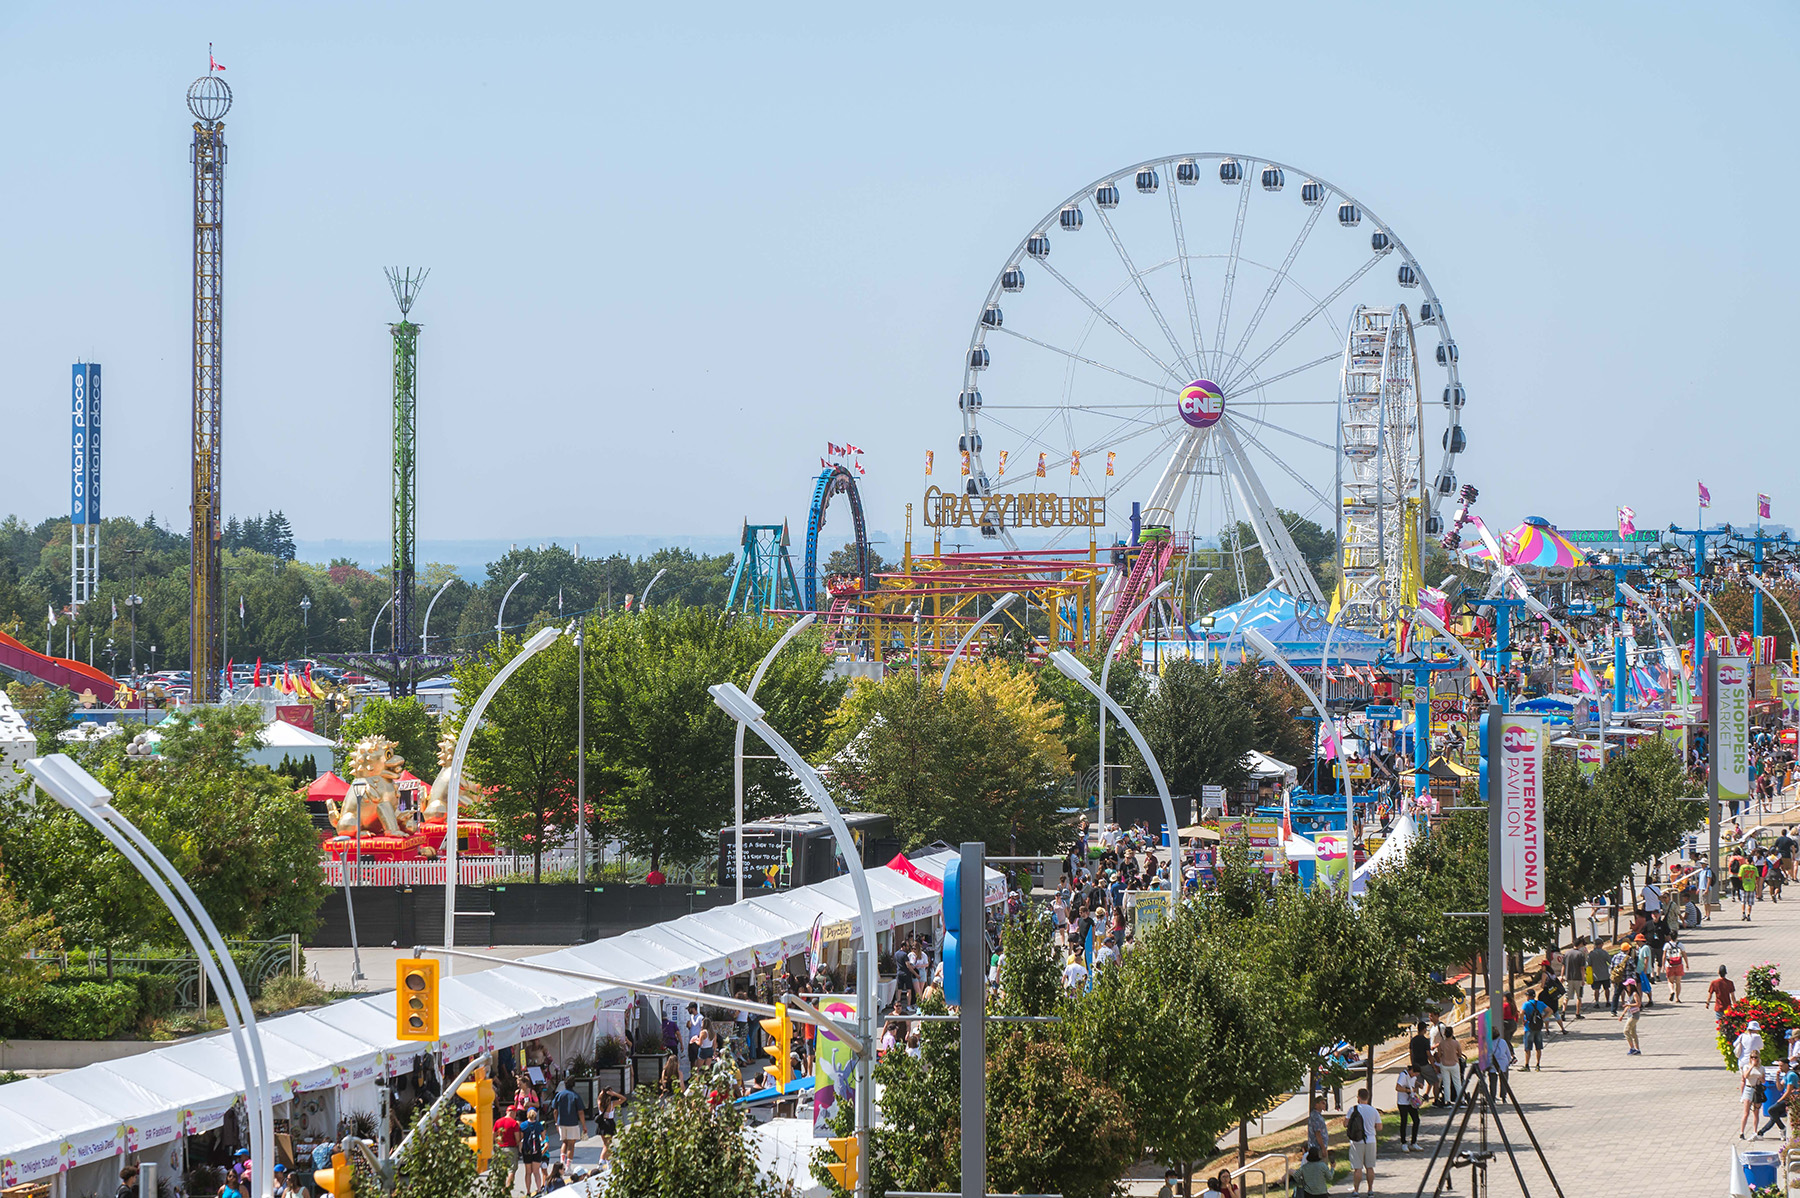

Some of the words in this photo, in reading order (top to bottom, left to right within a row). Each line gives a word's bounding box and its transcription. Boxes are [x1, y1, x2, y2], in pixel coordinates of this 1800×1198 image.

[72, 374, 85, 427] place
[90, 374, 101, 427] place
[1181, 397, 1222, 414] CNE
[73, 433, 84, 497] ontario
[91, 433, 100, 497] ontario
[924, 485, 1013, 528] CRAZY
[1016, 492, 1106, 528] MOUSE
[1624, 530, 1657, 542] ALLS
[1720, 669, 1744, 681] CNE
[1431, 711, 1467, 723] DOGS
[1719, 688, 1732, 749] MARKET
[1503, 732, 1538, 747] CNE
[1732, 688, 1745, 775] SHOPPERS
[1577, 748, 1600, 759] CNE
[1507, 757, 1521, 837] PAVILION
[1523, 757, 1538, 901] INTERNATIONAL
[1316, 841, 1348, 855] CNE
[1744, 869, 1755, 879] 27
[826, 925, 849, 939] Psychic
[520, 1024, 533, 1038] Quick
[533, 1022, 545, 1035] Draw
[546, 1016, 571, 1031] Caricatures
[152, 1124, 172, 1138] Fashions
[92, 1142, 104, 1154] Real
[21, 1159, 41, 1174] ToNight
[42, 1155, 58, 1169] Studio
